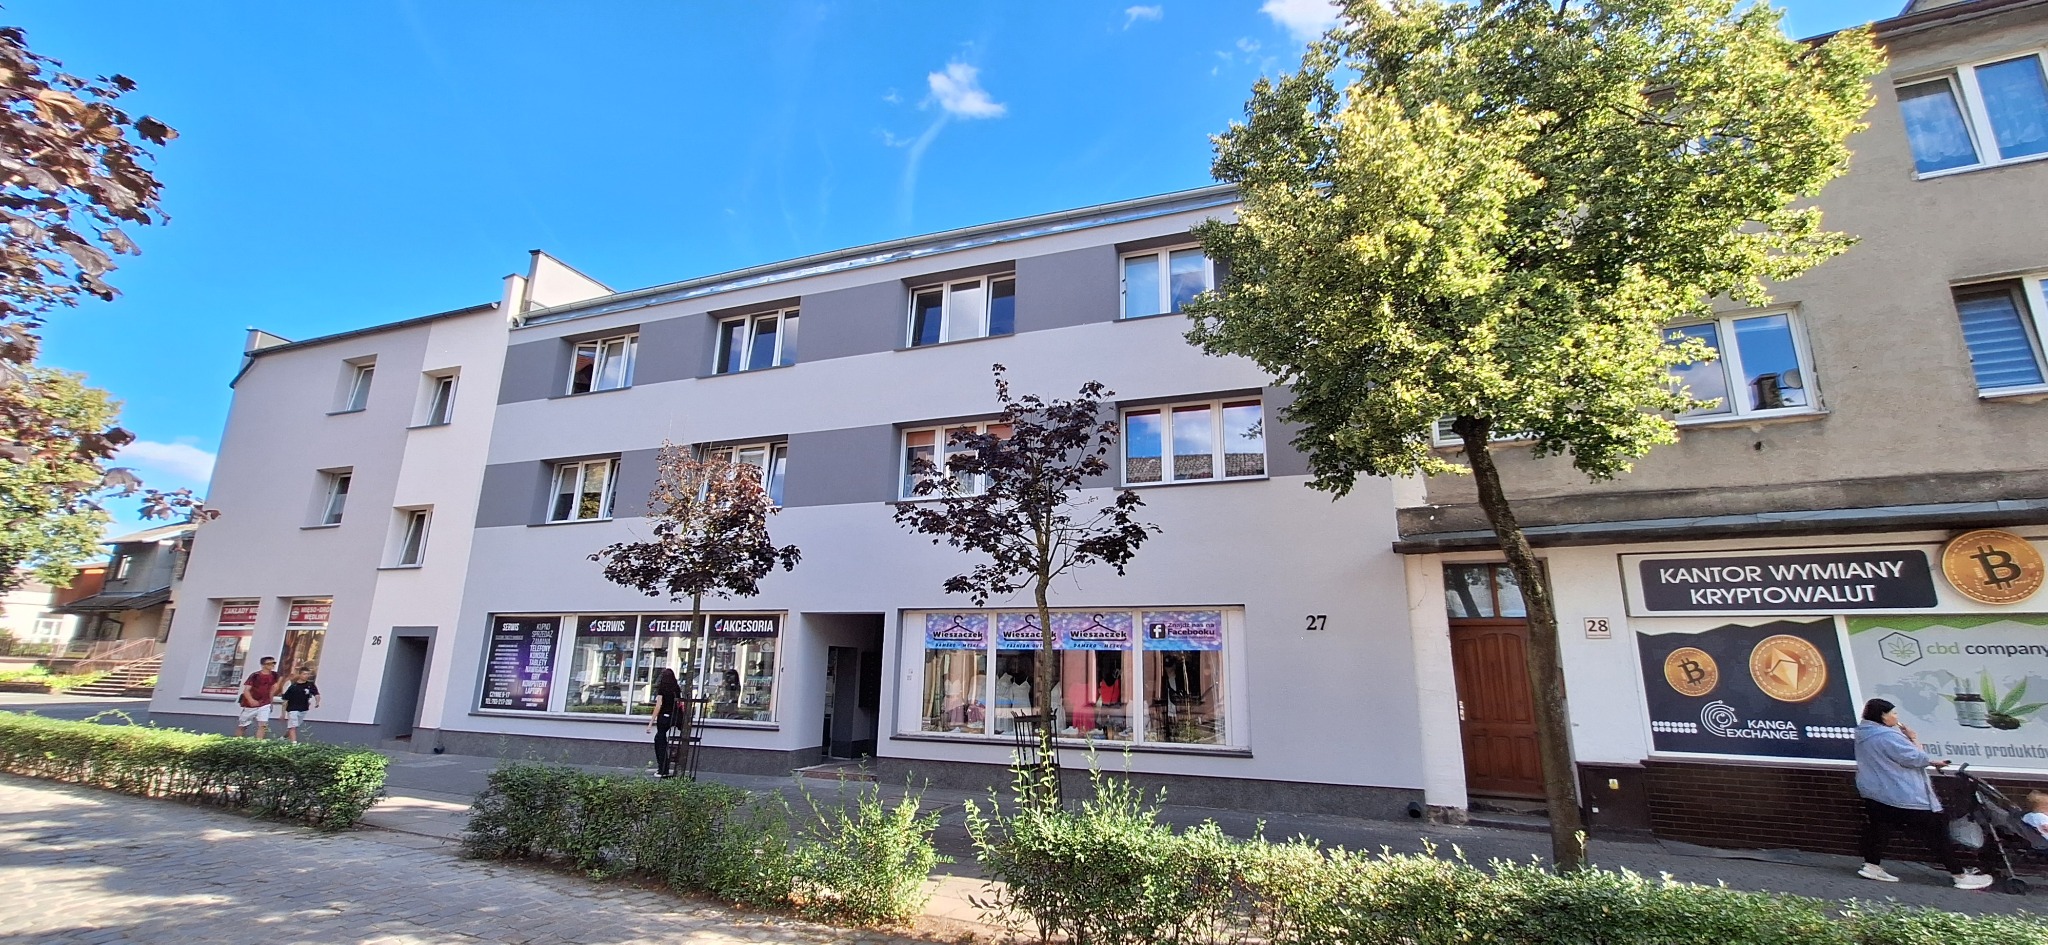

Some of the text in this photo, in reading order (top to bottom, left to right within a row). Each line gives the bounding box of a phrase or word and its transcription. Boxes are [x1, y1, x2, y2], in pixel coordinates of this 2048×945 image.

[1660, 561, 1903, 583] KANTOR WYMIANY
[1690, 585, 1876, 604] KRYPTOWALUT
[597, 621, 625, 632] SERWIS
[656, 621, 694, 632] TELEFON
[723, 620, 773, 632] AKCESORIA
[1306, 615, 1327, 630] 27
[1587, 620, 1608, 632] 28
[372, 636, 382, 645] 26
[1927, 642, 2048, 657] cbd company
[1747, 720, 1796, 730] KANGA
[1726, 728, 1799, 740] EXCHANGE
[1922, 741, 1942, 756] naj
[1945, 741, 1981, 756] świat
